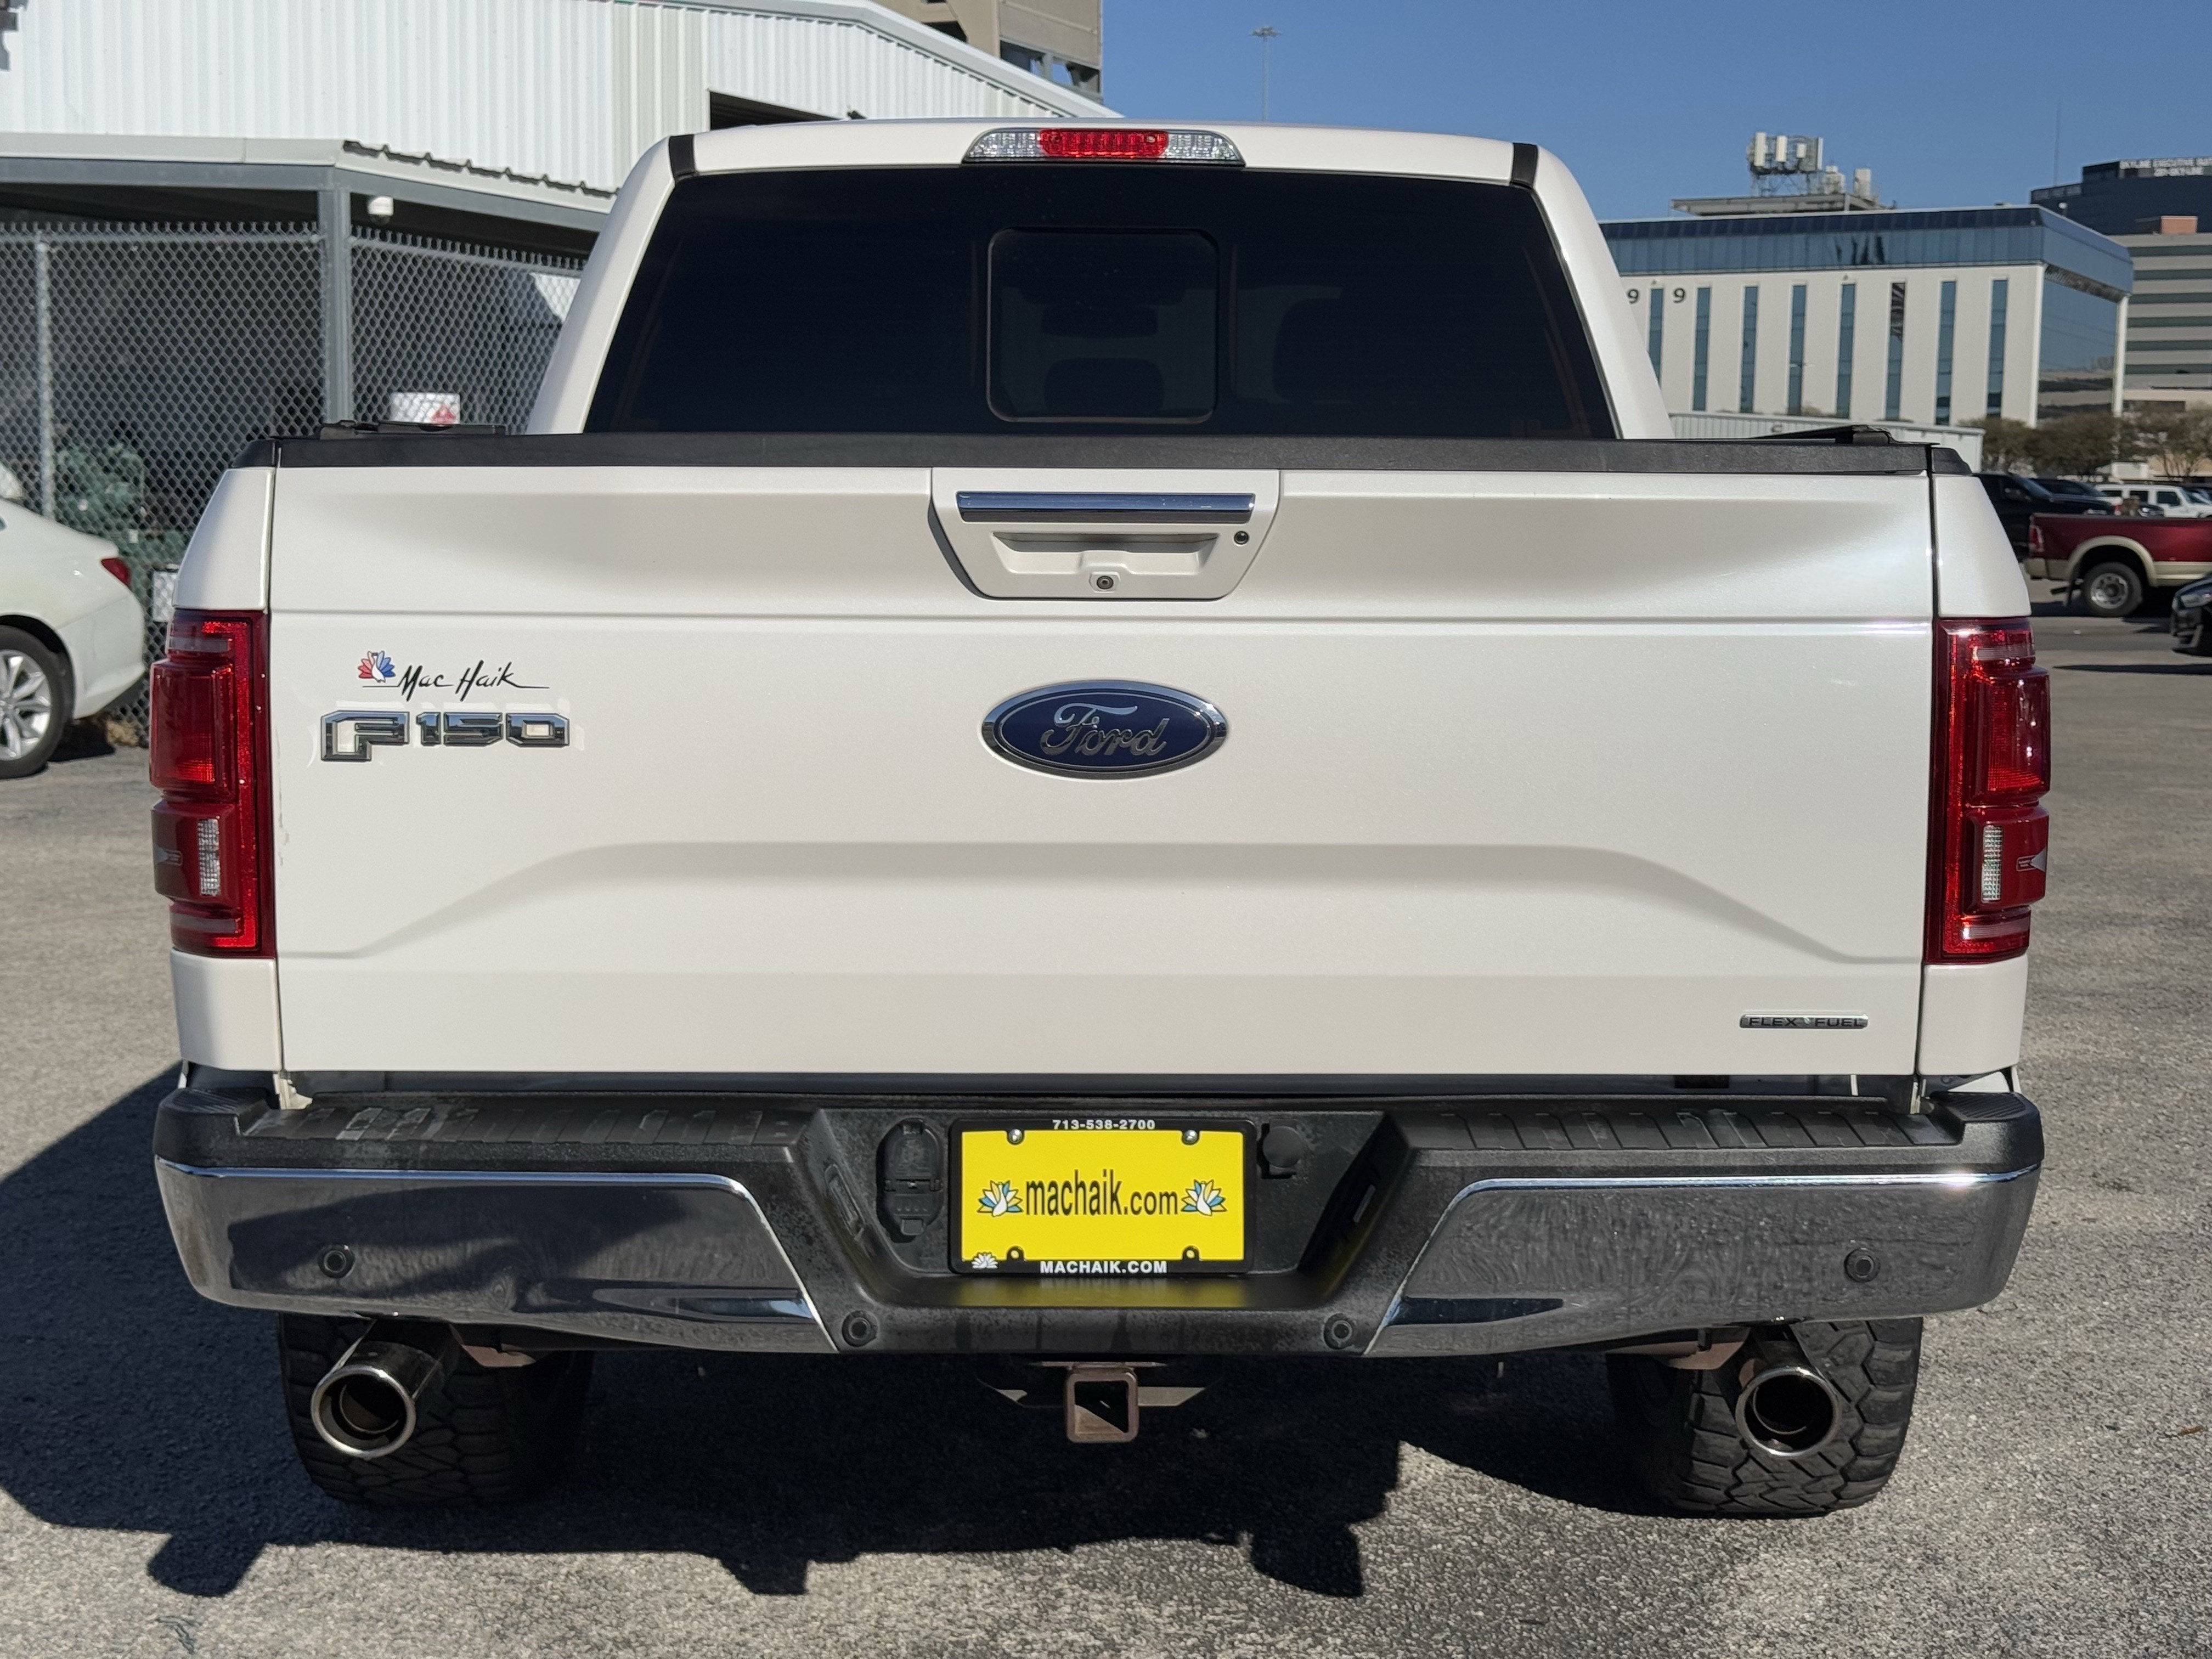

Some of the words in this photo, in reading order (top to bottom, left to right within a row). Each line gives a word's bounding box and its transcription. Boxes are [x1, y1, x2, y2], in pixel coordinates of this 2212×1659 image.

[1673, 287, 1685, 303] 9
[387, 664, 454, 702] Mac
[455, 659, 549, 702] Haik
[1040, 703, 1170, 756] Ford
[1748, 1017, 1798, 1026] FLEX
[1814, 1018, 1863, 1027] FUEL
[1052, 1119, 1156, 1130] 713-538-2700
[1025, 1169, 1179, 1216] machaik.com
[1040, 1260, 1167, 1274] MACHAIK.COM
